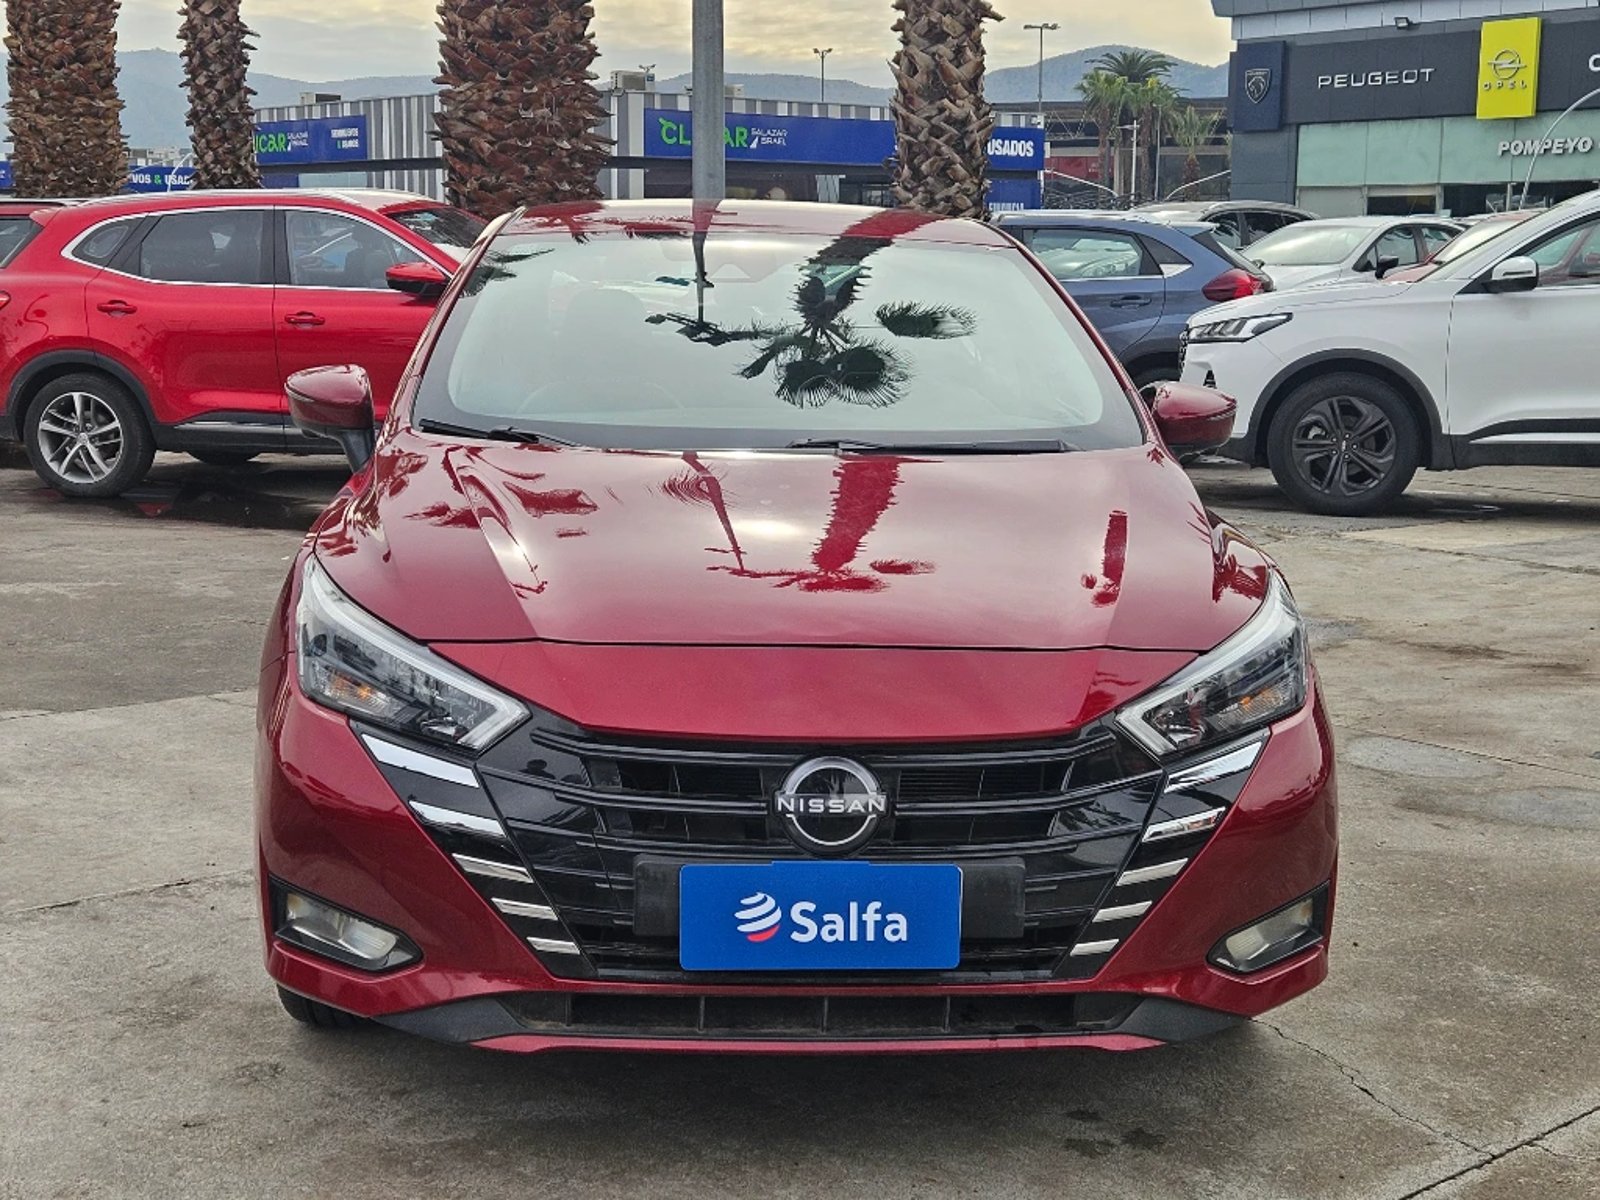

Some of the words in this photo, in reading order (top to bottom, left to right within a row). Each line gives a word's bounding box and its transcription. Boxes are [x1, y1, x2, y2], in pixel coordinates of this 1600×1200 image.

[1318, 68, 1435, 88] PEUGEOT
[1483, 80, 1527, 90] OPEL
[987, 138, 1034, 157] USADOS
[1498, 136, 1594, 156] POMPEYO
[778, 796, 885, 813] NISSAN
[790, 900, 908, 942] Salfa
